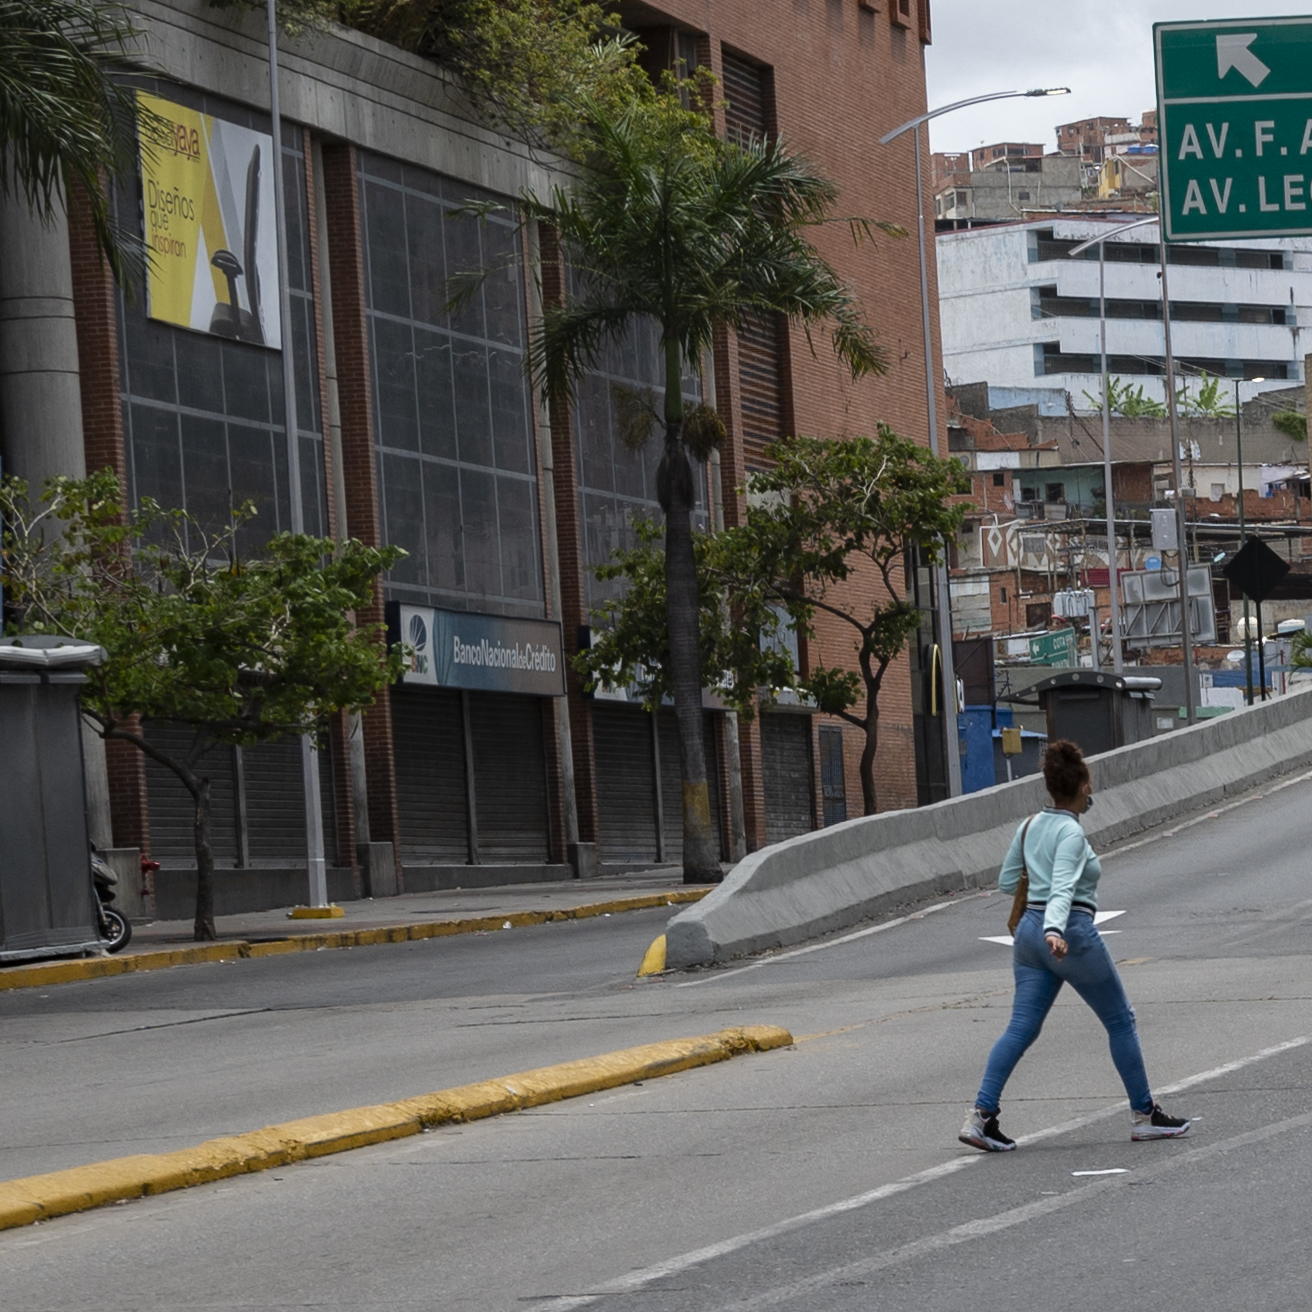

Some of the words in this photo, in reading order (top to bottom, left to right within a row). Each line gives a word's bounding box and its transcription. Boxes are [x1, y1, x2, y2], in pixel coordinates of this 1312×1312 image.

[1178, 121, 1243, 161] AV.
[1254, 120, 1288, 157] F.
[148, 179, 195, 221] Diseños
[1181, 177, 1246, 216] AV.
[149, 210, 169, 233] que
[151, 230, 188, 259] inspiran
